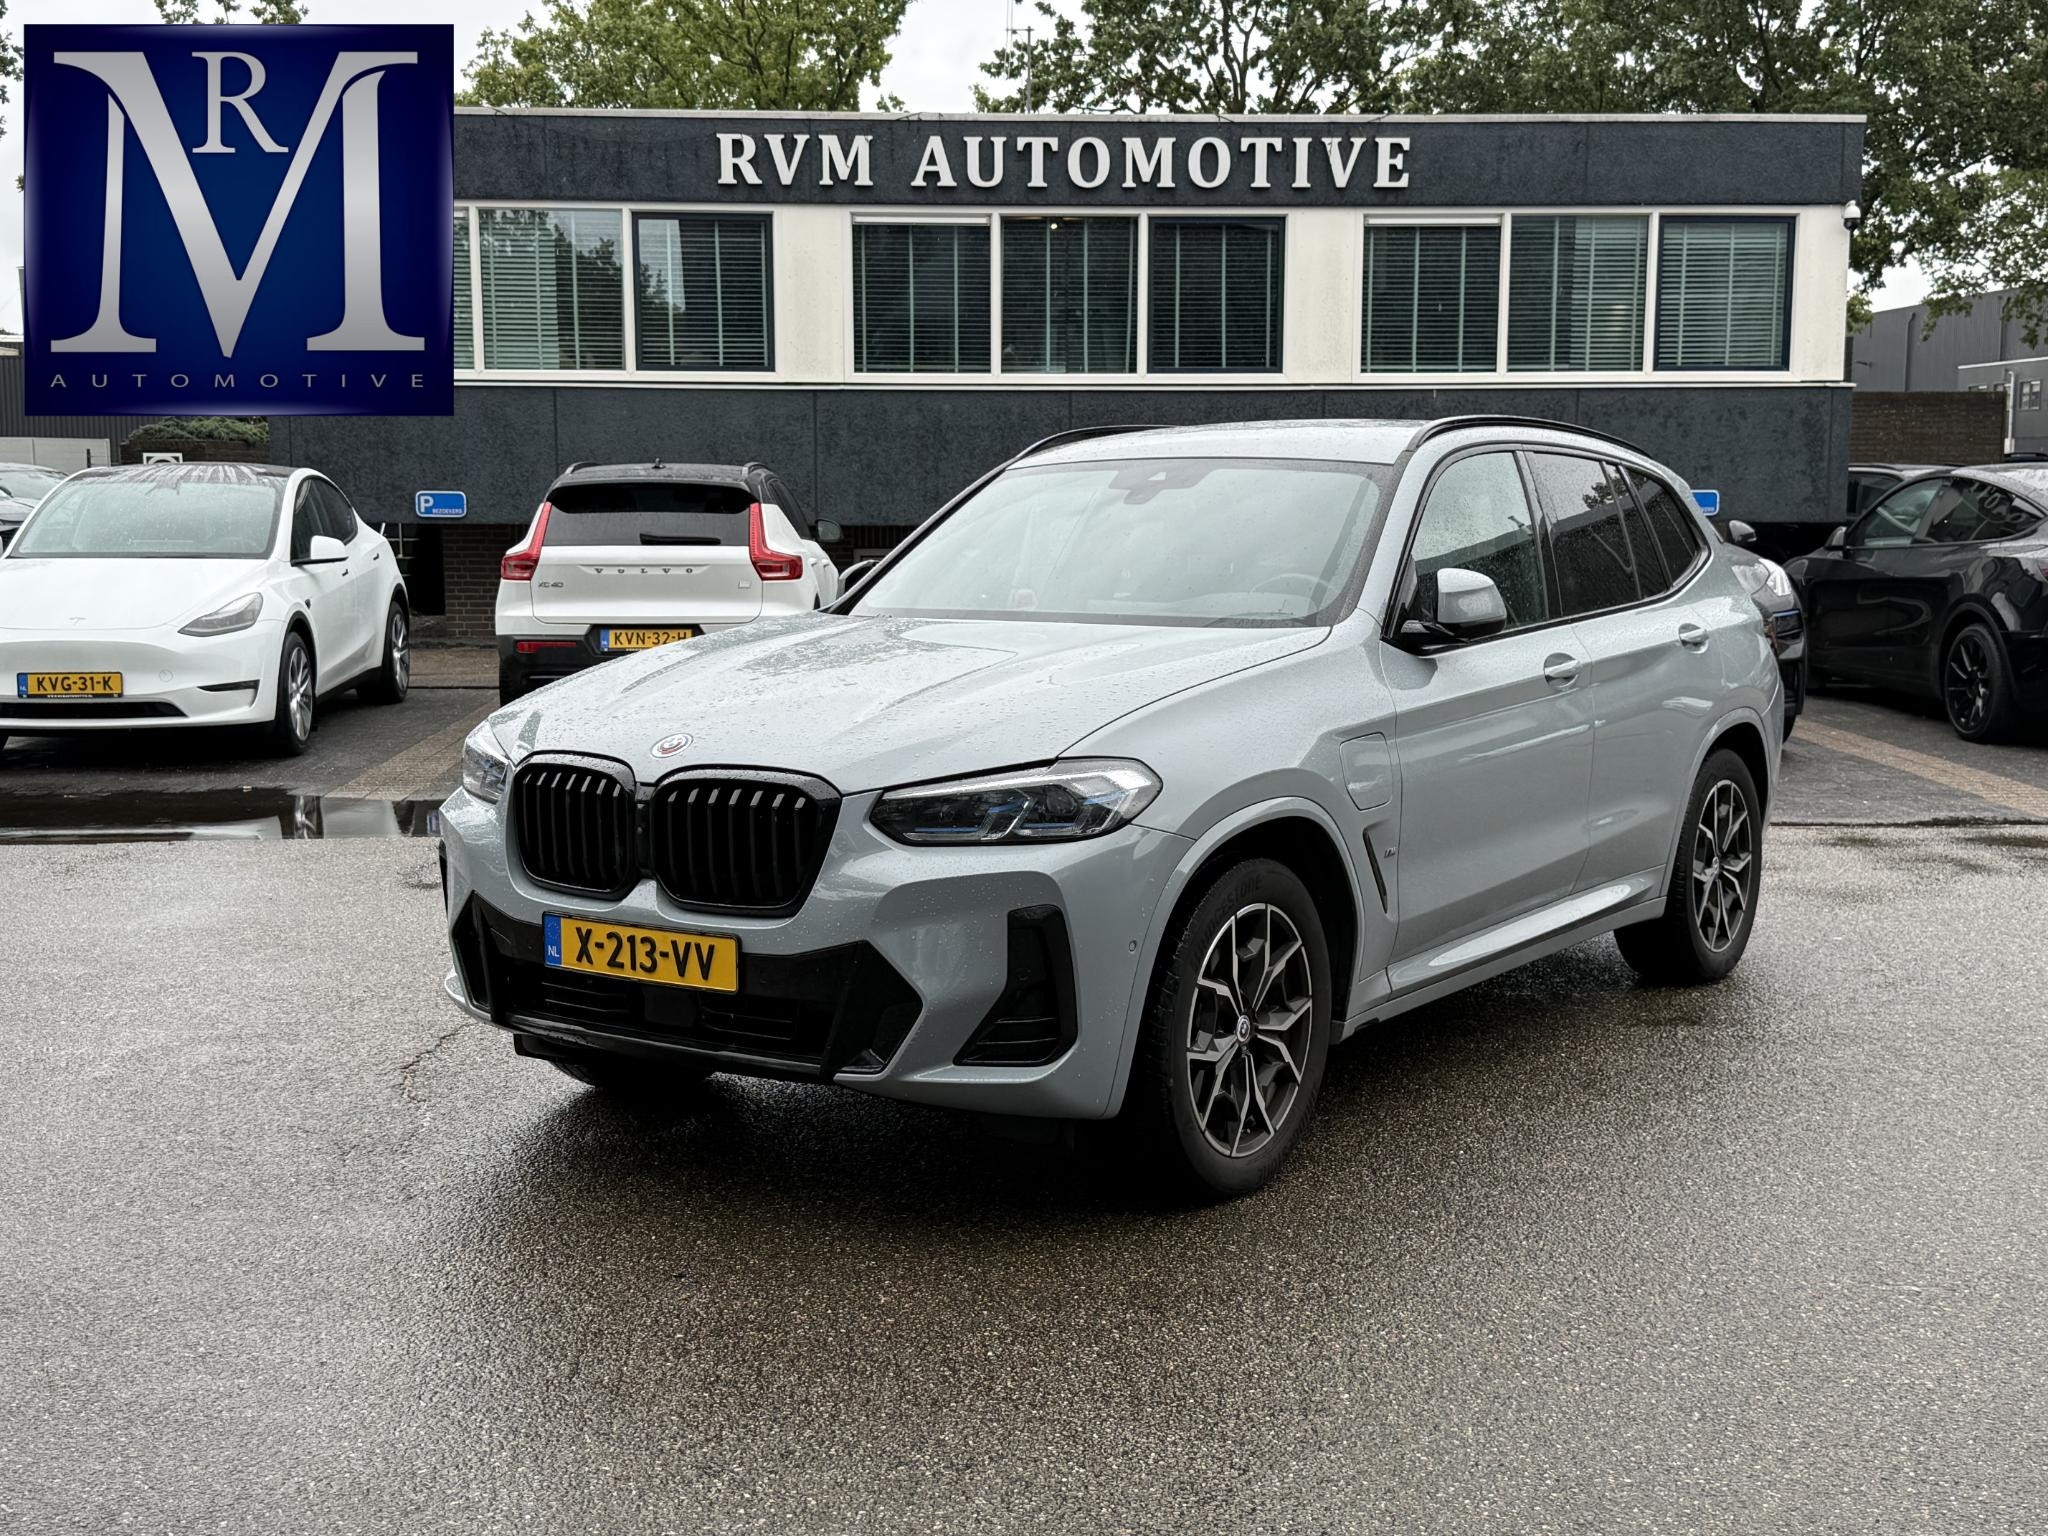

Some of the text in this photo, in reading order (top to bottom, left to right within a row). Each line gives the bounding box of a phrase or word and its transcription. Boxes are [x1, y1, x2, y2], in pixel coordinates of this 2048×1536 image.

[716, 132, 1412, 189] RVM AUTOMOTIVE
[420, 495, 434, 513] P
[594, 567, 694, 575] VOLVO
[36, 676, 113, 692] KVG-31-K
[548, 927, 715, 981] NL X-213-VV
